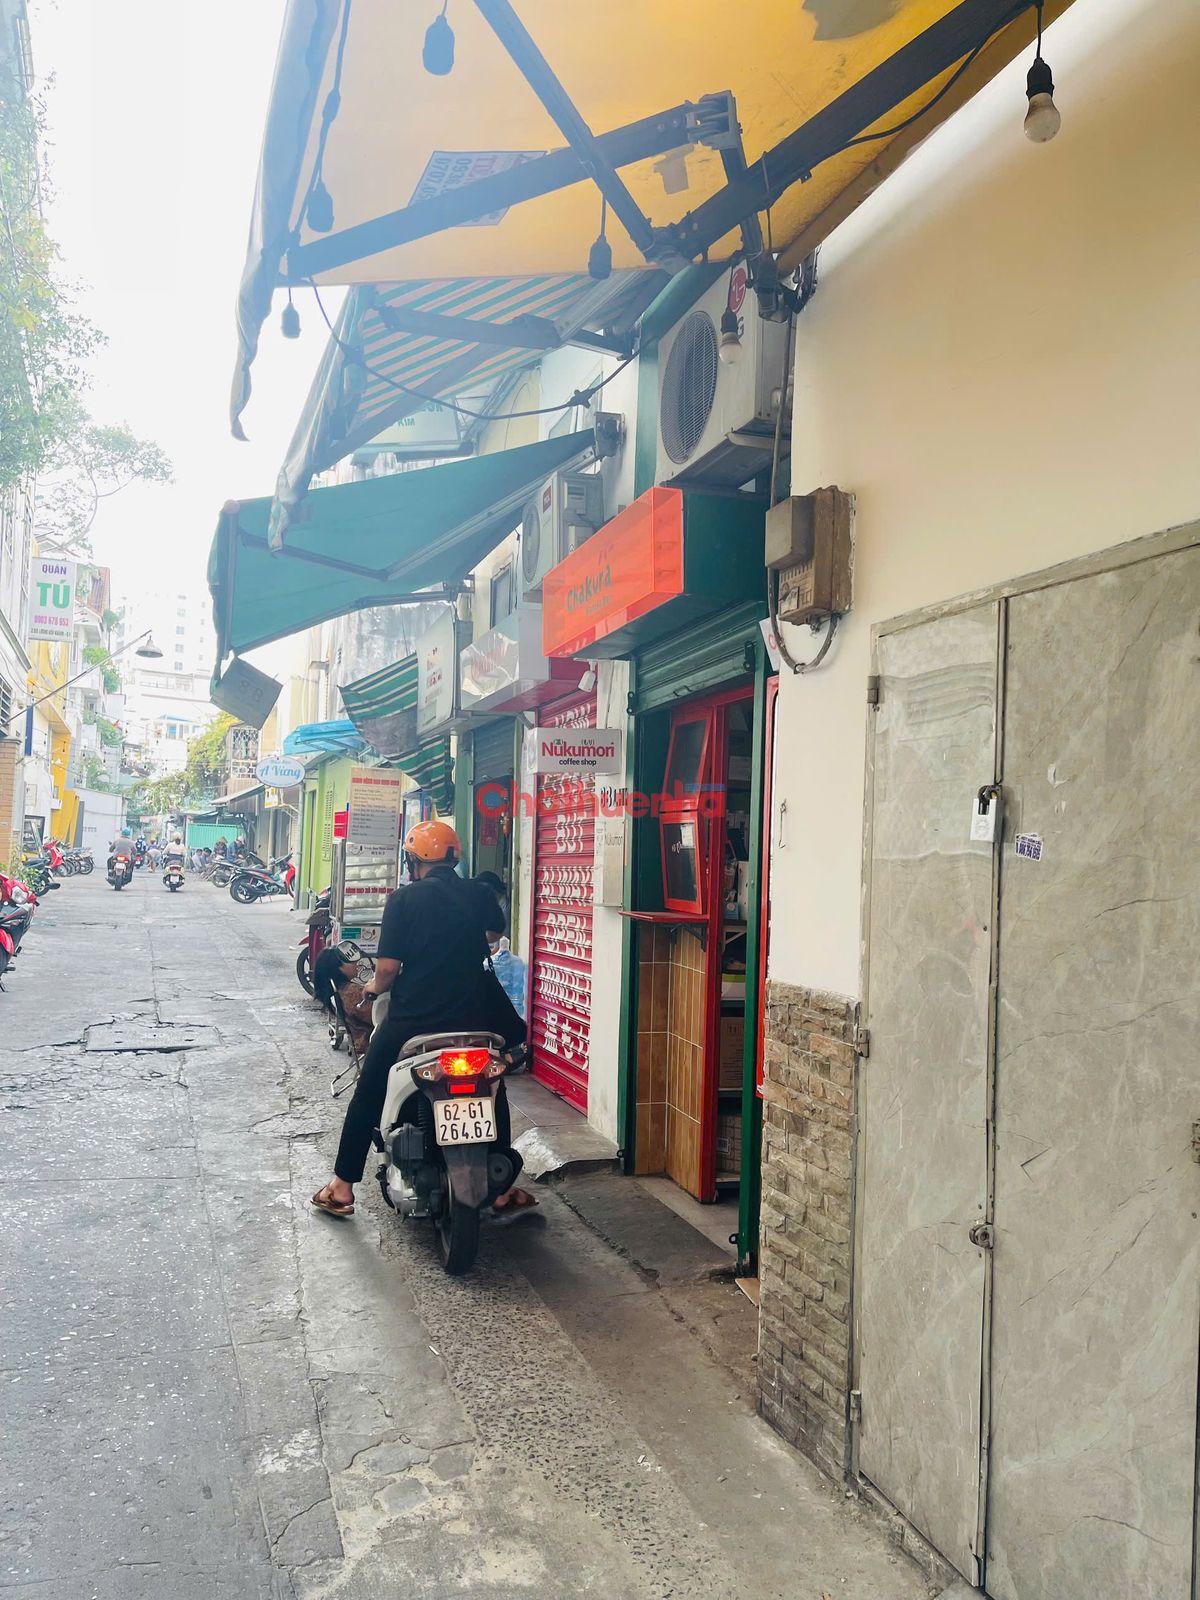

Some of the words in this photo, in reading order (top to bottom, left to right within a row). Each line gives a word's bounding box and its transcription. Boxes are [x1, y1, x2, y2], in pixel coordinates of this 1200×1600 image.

[37, 579, 70, 609] TÚ
[540, 866, 593, 907] ALWAY
[443, 1101, 484, 1121] 62-G1
[440, 1120, 493, 1142] 264.62
